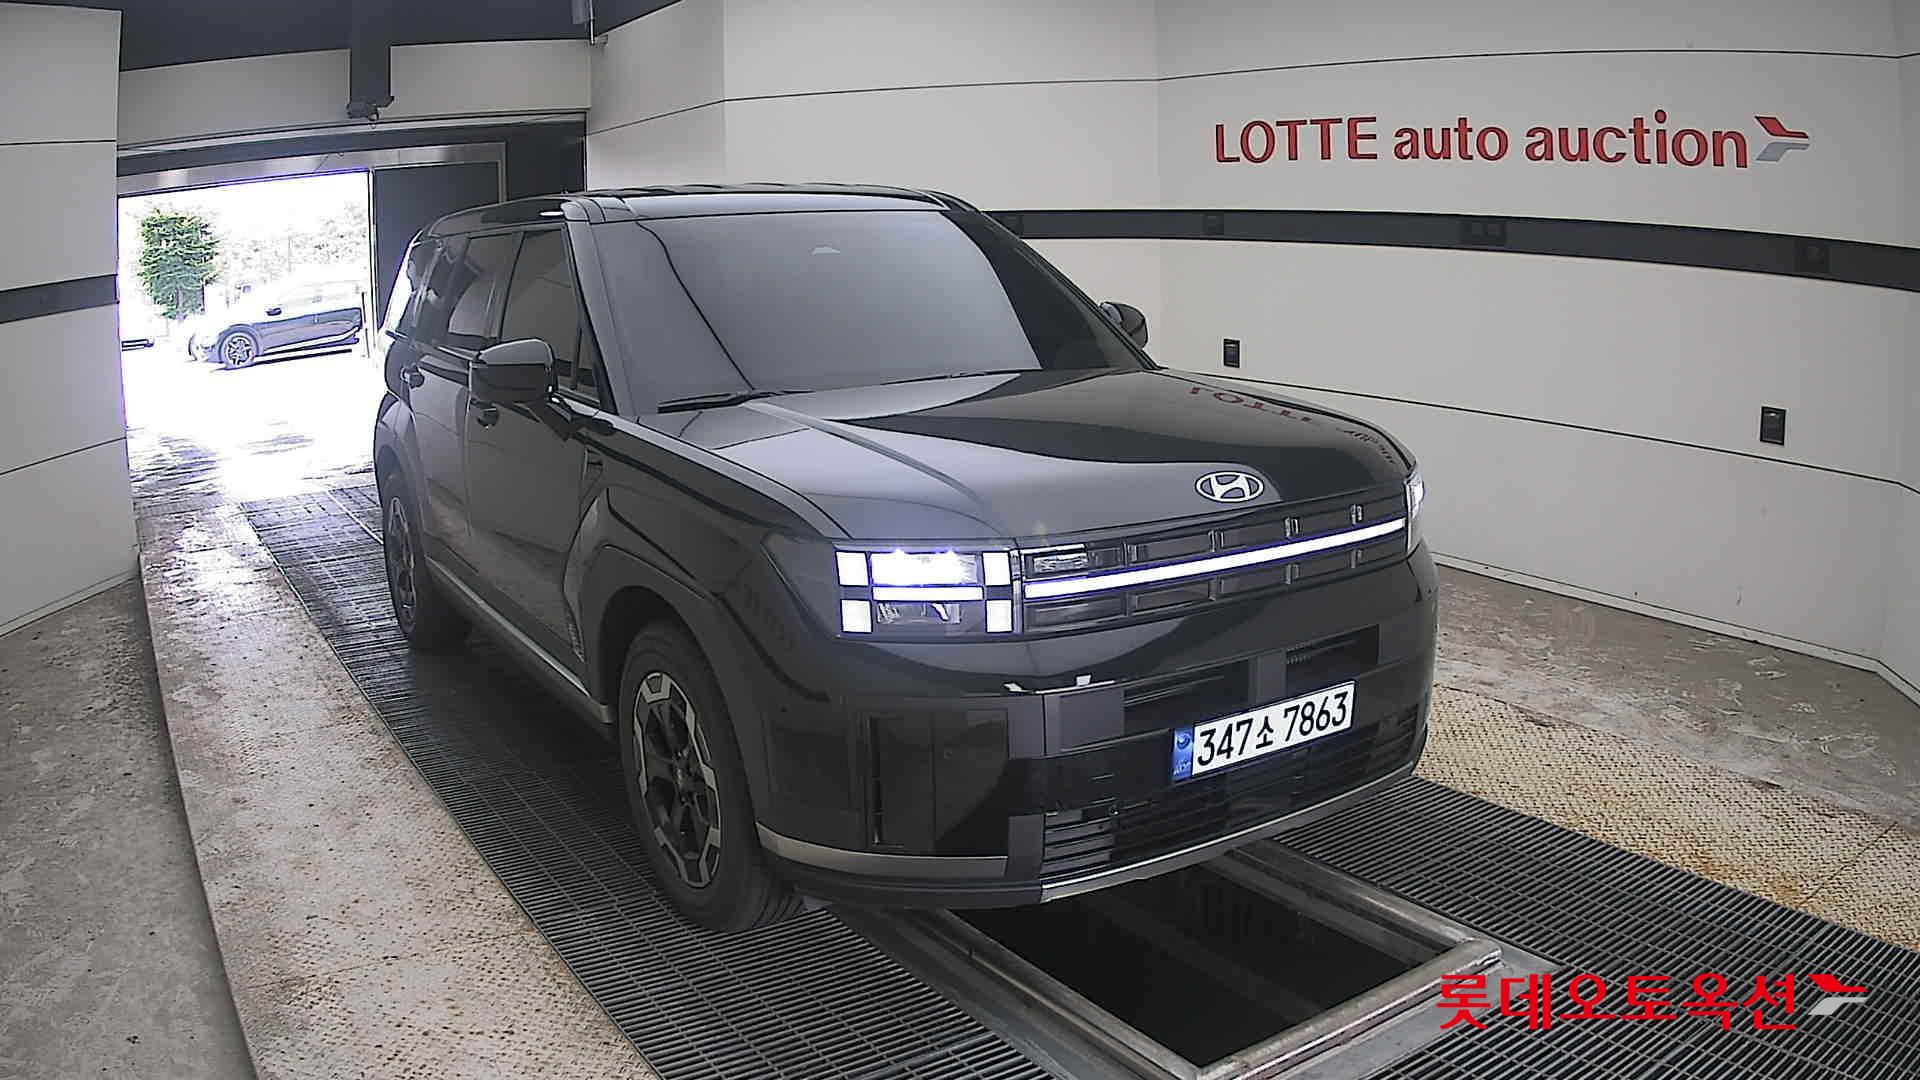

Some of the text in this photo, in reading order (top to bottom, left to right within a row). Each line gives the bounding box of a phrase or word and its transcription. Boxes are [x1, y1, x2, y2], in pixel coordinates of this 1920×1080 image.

[1215, 109, 1748, 168] LOTTE auto auction
[1197, 691, 1349, 766] 347소 7863
